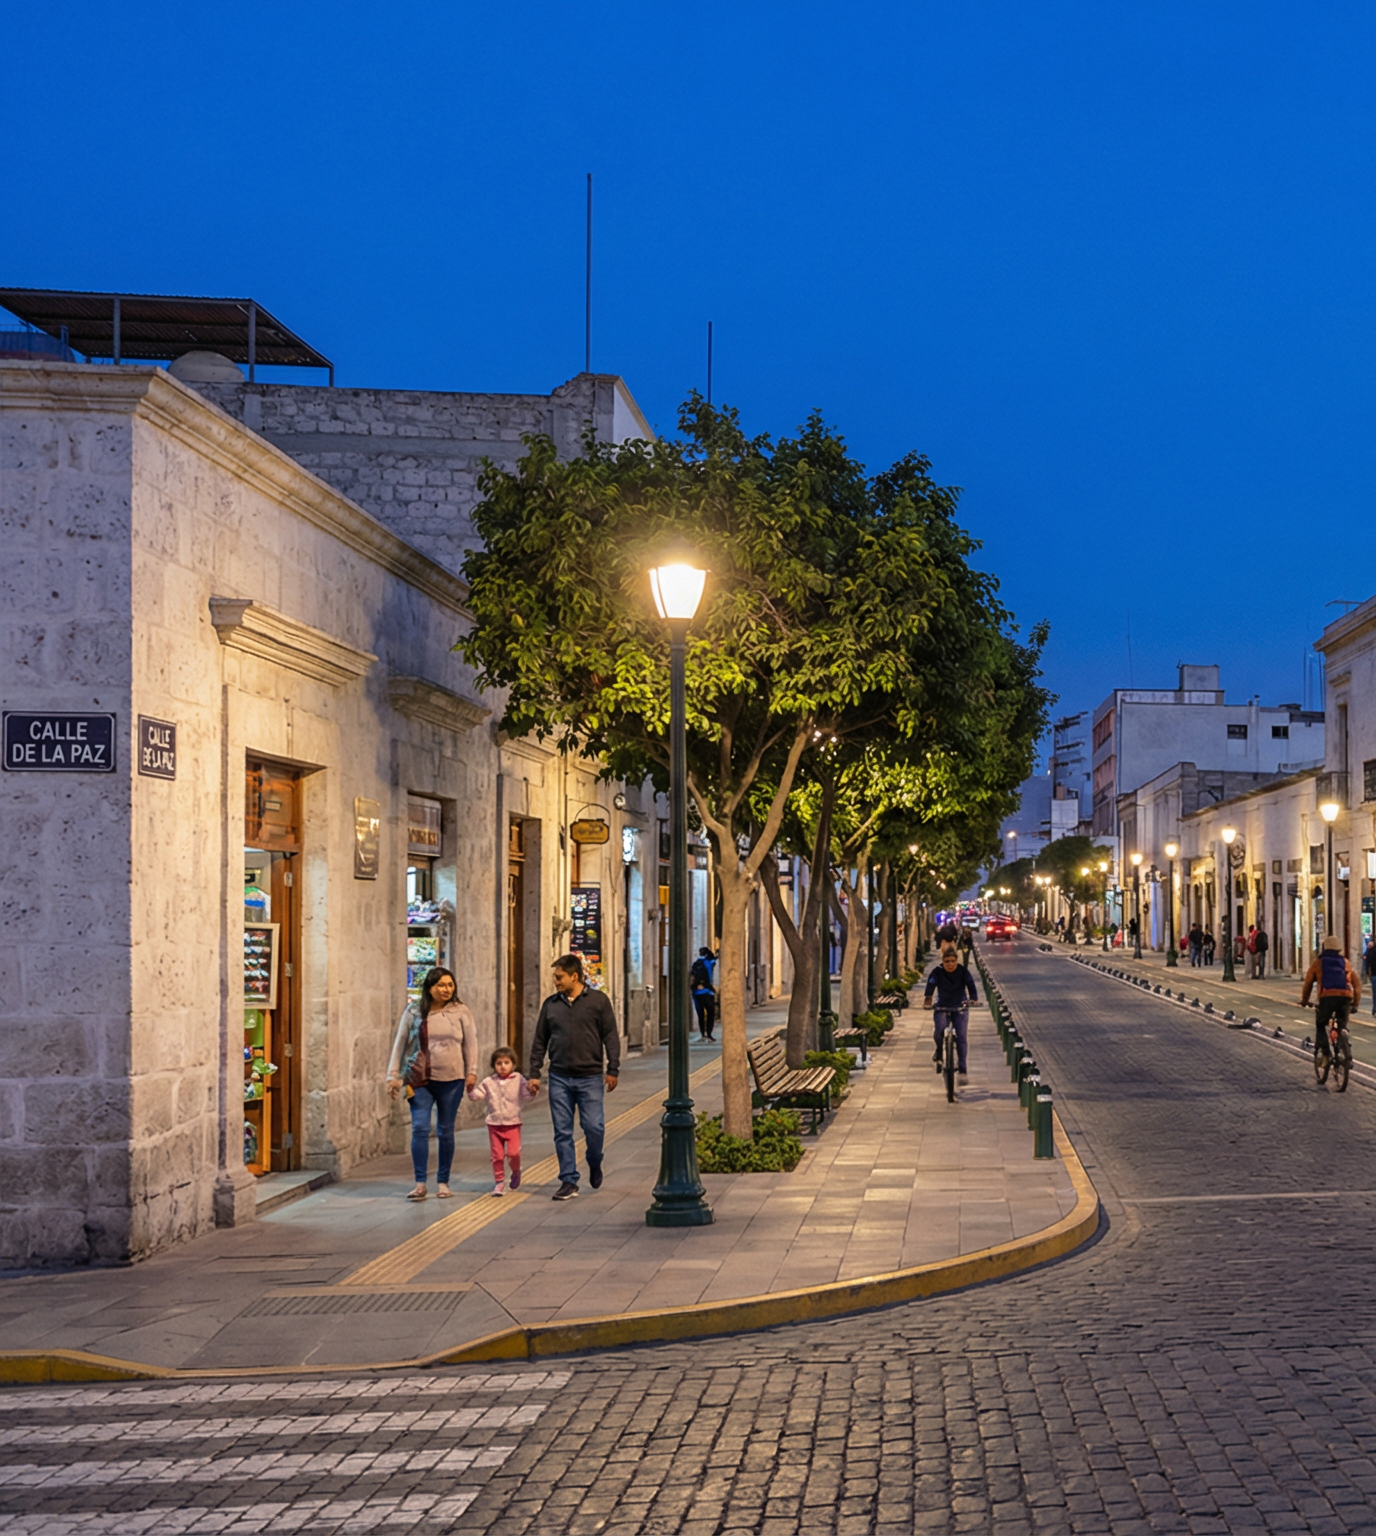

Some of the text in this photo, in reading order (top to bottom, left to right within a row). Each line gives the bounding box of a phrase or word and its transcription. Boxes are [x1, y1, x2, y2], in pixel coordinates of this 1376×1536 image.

[29, 720, 88, 741] CALLE
[148, 726, 171, 749] CALLE
[12, 743, 106, 764] DE LA PAZ
